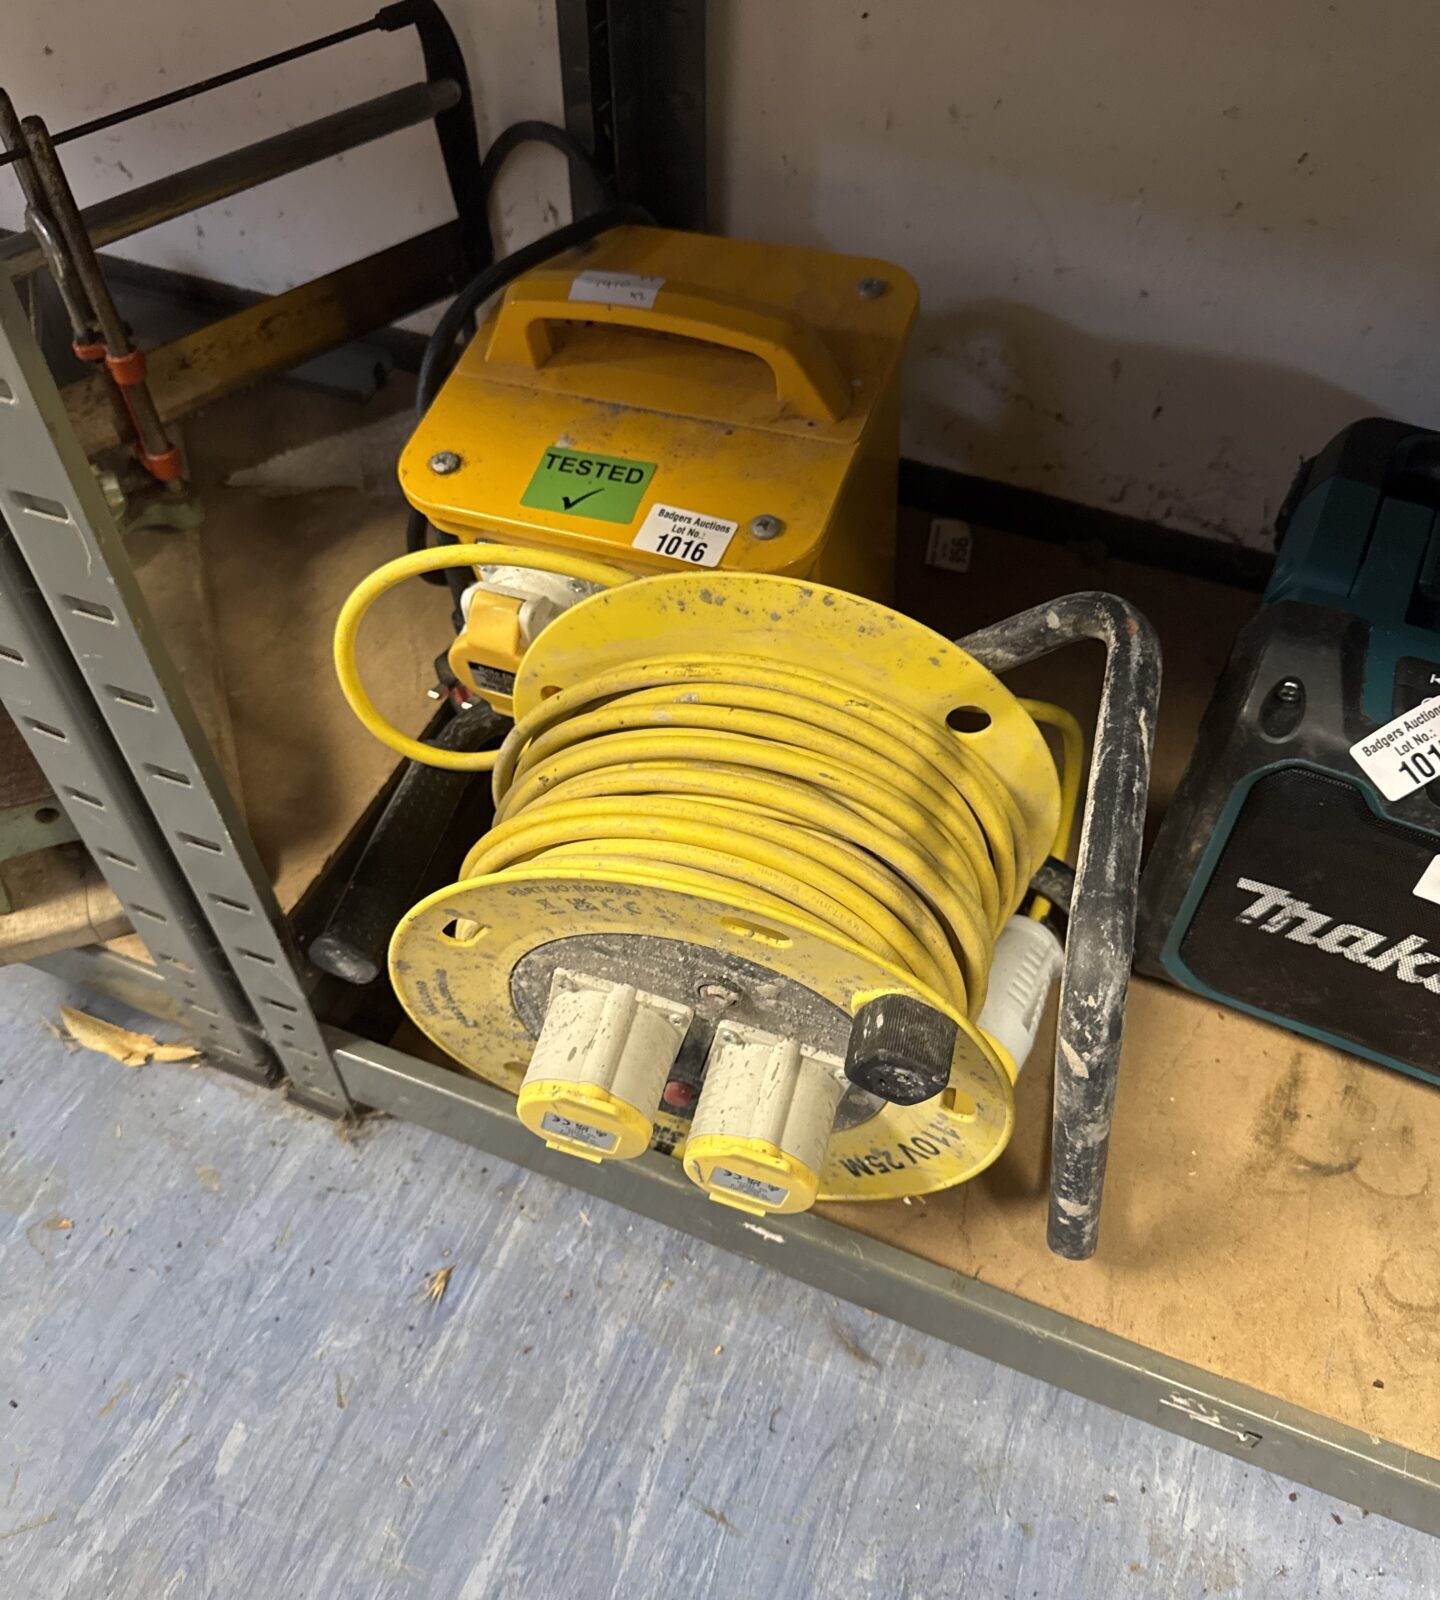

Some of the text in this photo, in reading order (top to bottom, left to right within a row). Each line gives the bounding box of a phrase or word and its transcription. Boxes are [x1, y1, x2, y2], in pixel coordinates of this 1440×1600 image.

[546, 453, 644, 485] TESTED
[658, 508, 731, 534] Badgers Auctions
[672, 524, 686, 535] Lot
[656, 533, 708, 562] 1016
[1362, 728, 1405, 757] Badgers
[1394, 740, 1415, 756] Lot
[839, 1123, 960, 1177] 110V 25M
